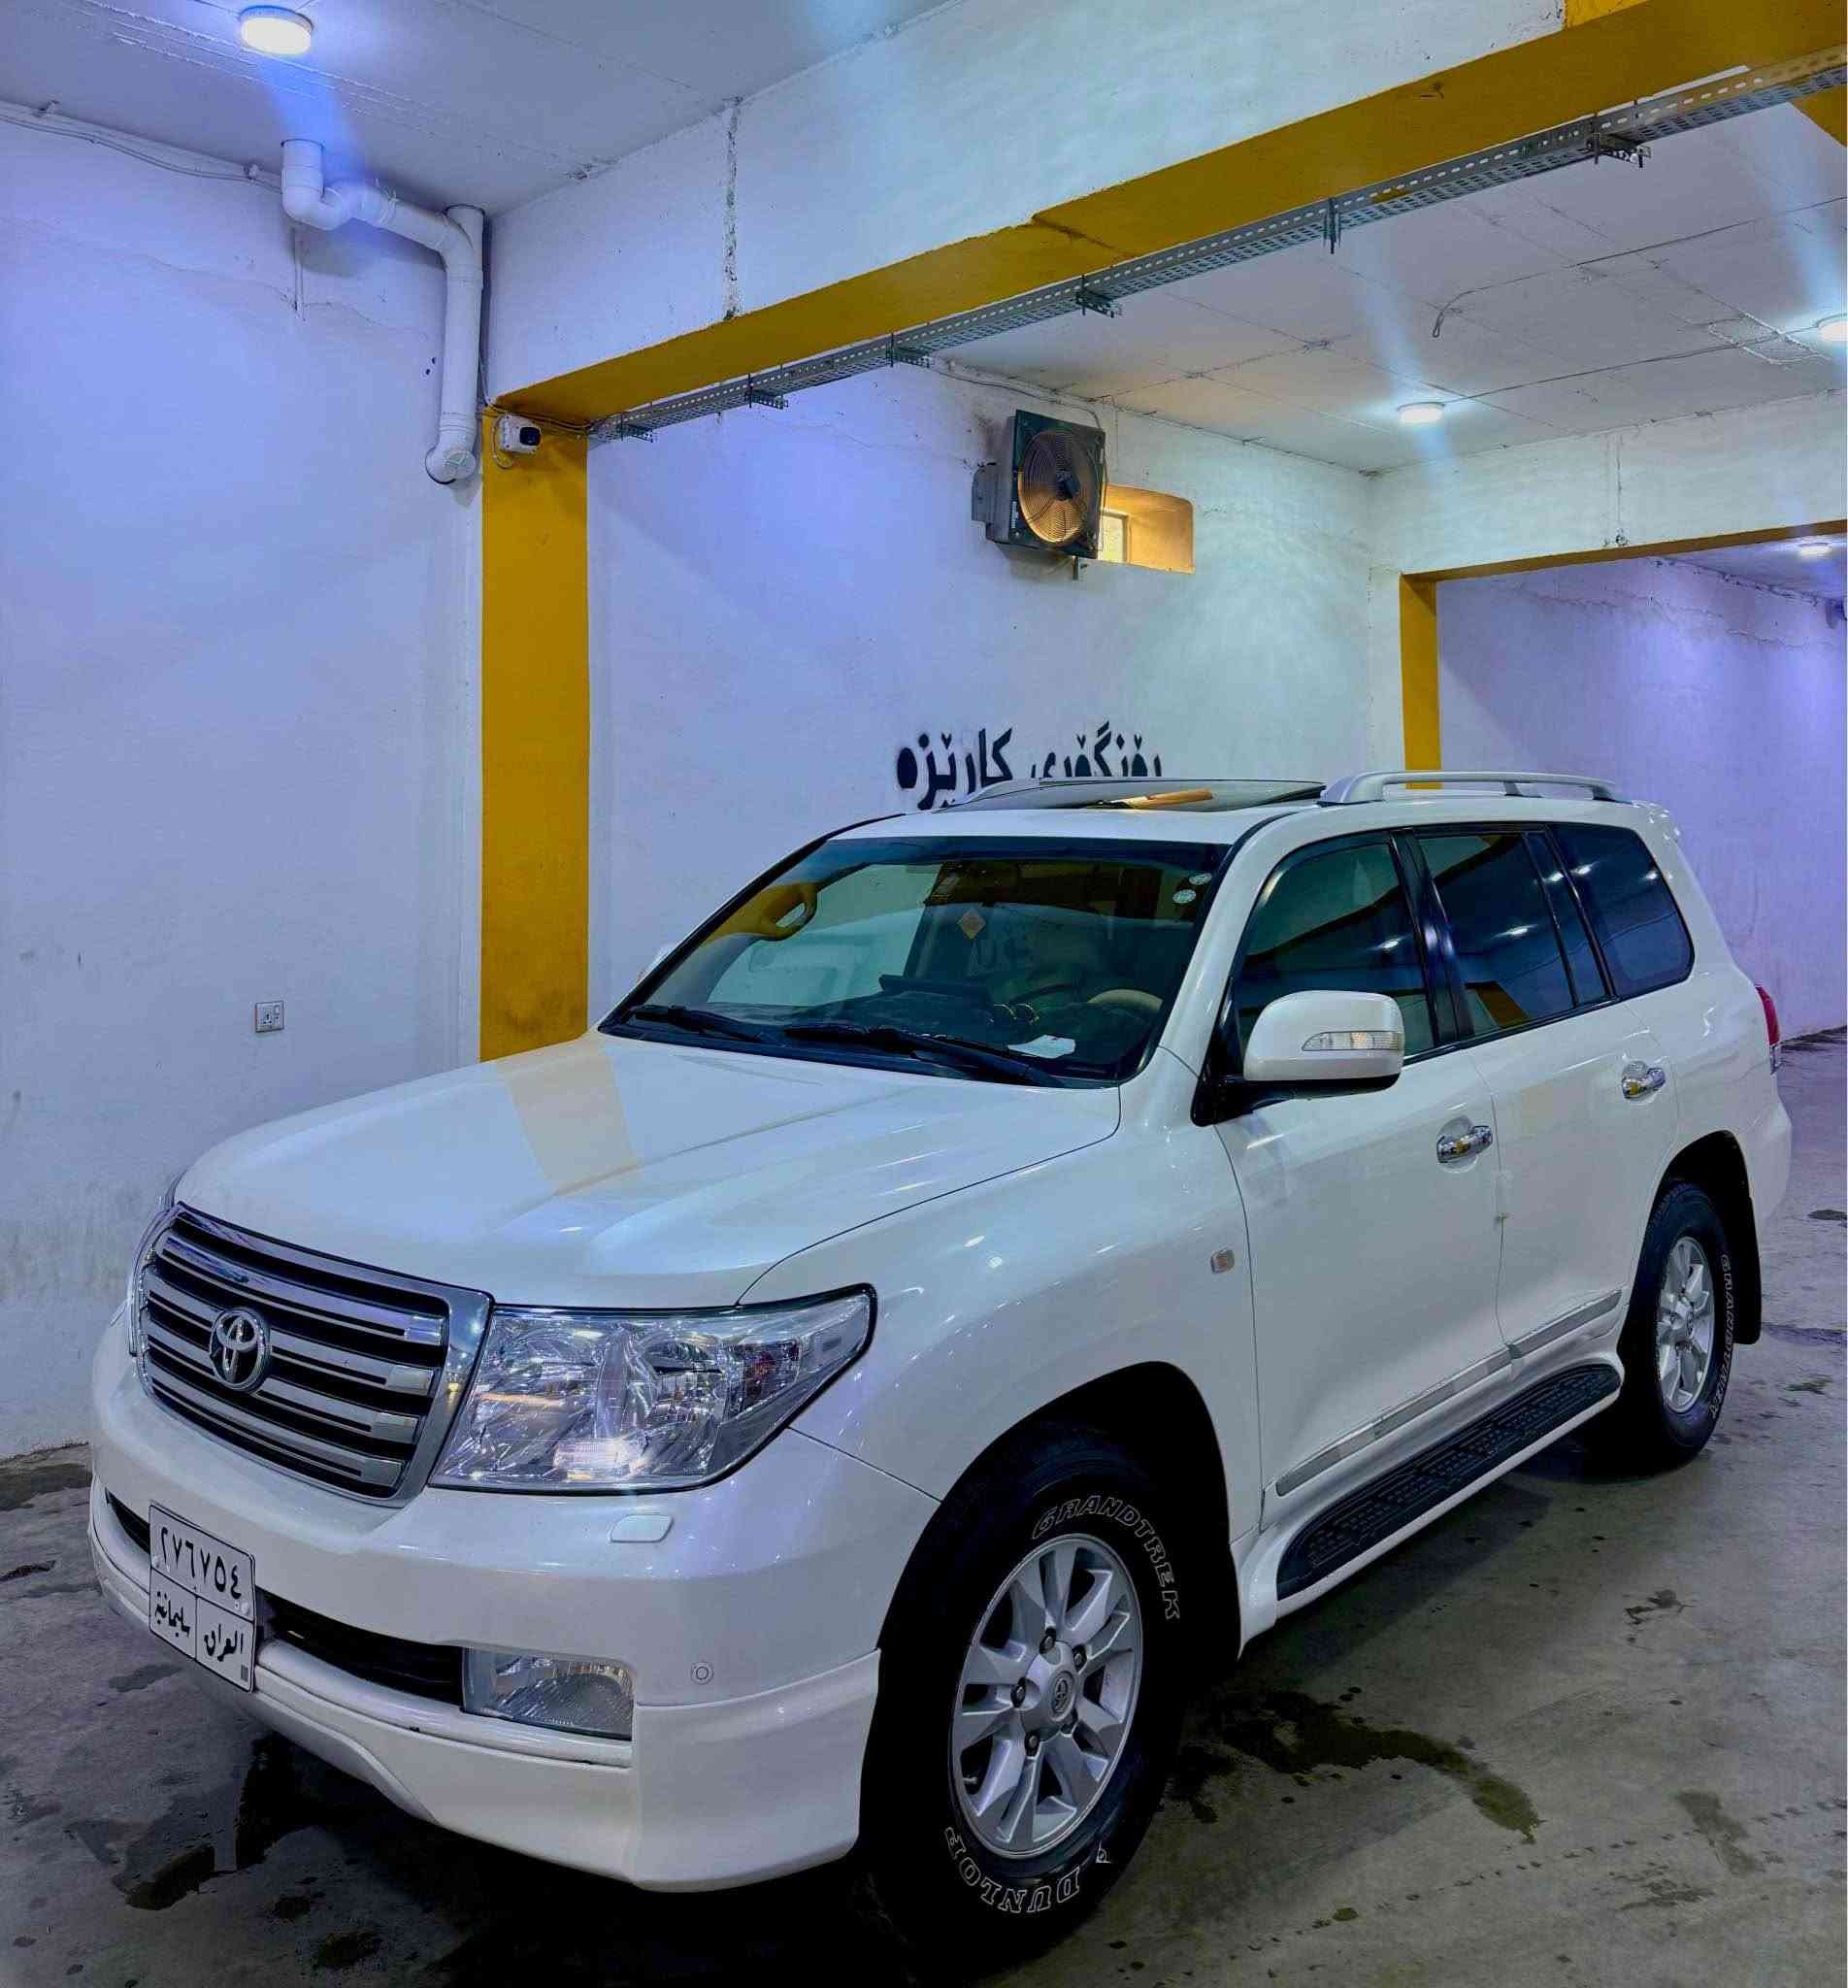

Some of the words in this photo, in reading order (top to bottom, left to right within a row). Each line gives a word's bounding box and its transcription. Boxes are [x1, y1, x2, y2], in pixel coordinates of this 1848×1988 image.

[160, 1526, 242, 1600] ٢٧٦٧٥٤
[1032, 1494, 1180, 1619] GRANDTREK
[943, 1826, 1081, 1914] DUNLOP
